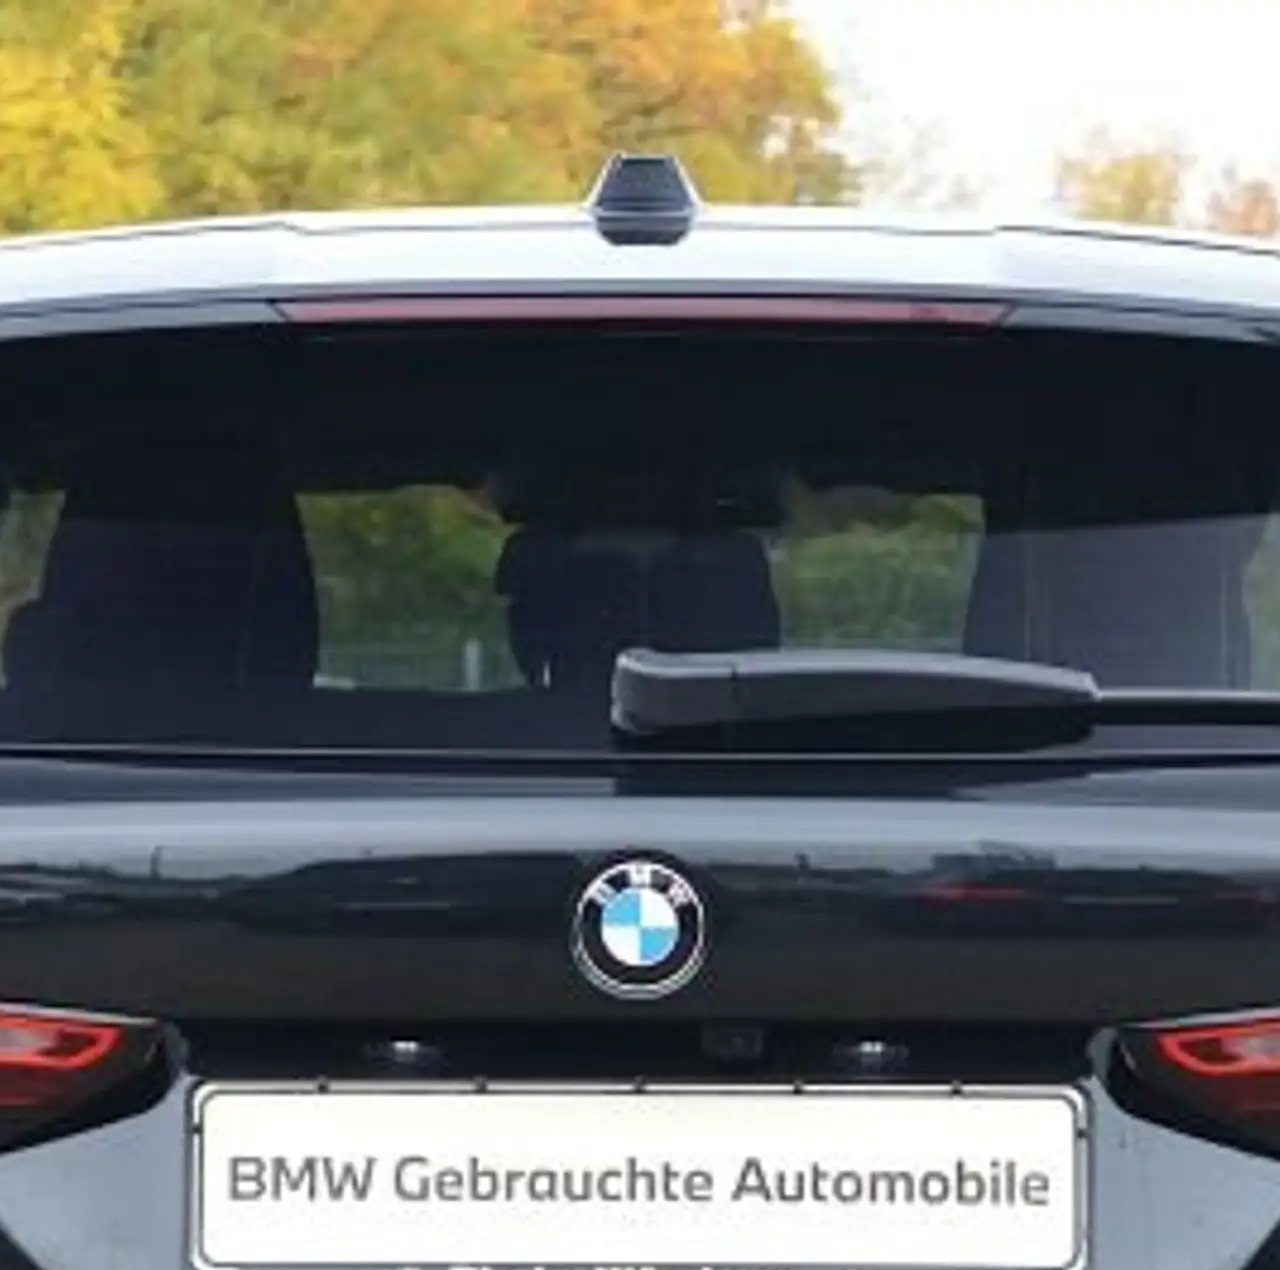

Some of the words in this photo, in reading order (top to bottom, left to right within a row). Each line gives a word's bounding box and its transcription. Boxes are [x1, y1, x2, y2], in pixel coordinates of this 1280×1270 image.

[228, 1156, 377, 1201] BMW
[393, 1156, 715, 1203] Gebrauchte
[730, 1156, 1051, 1206] Automobile
